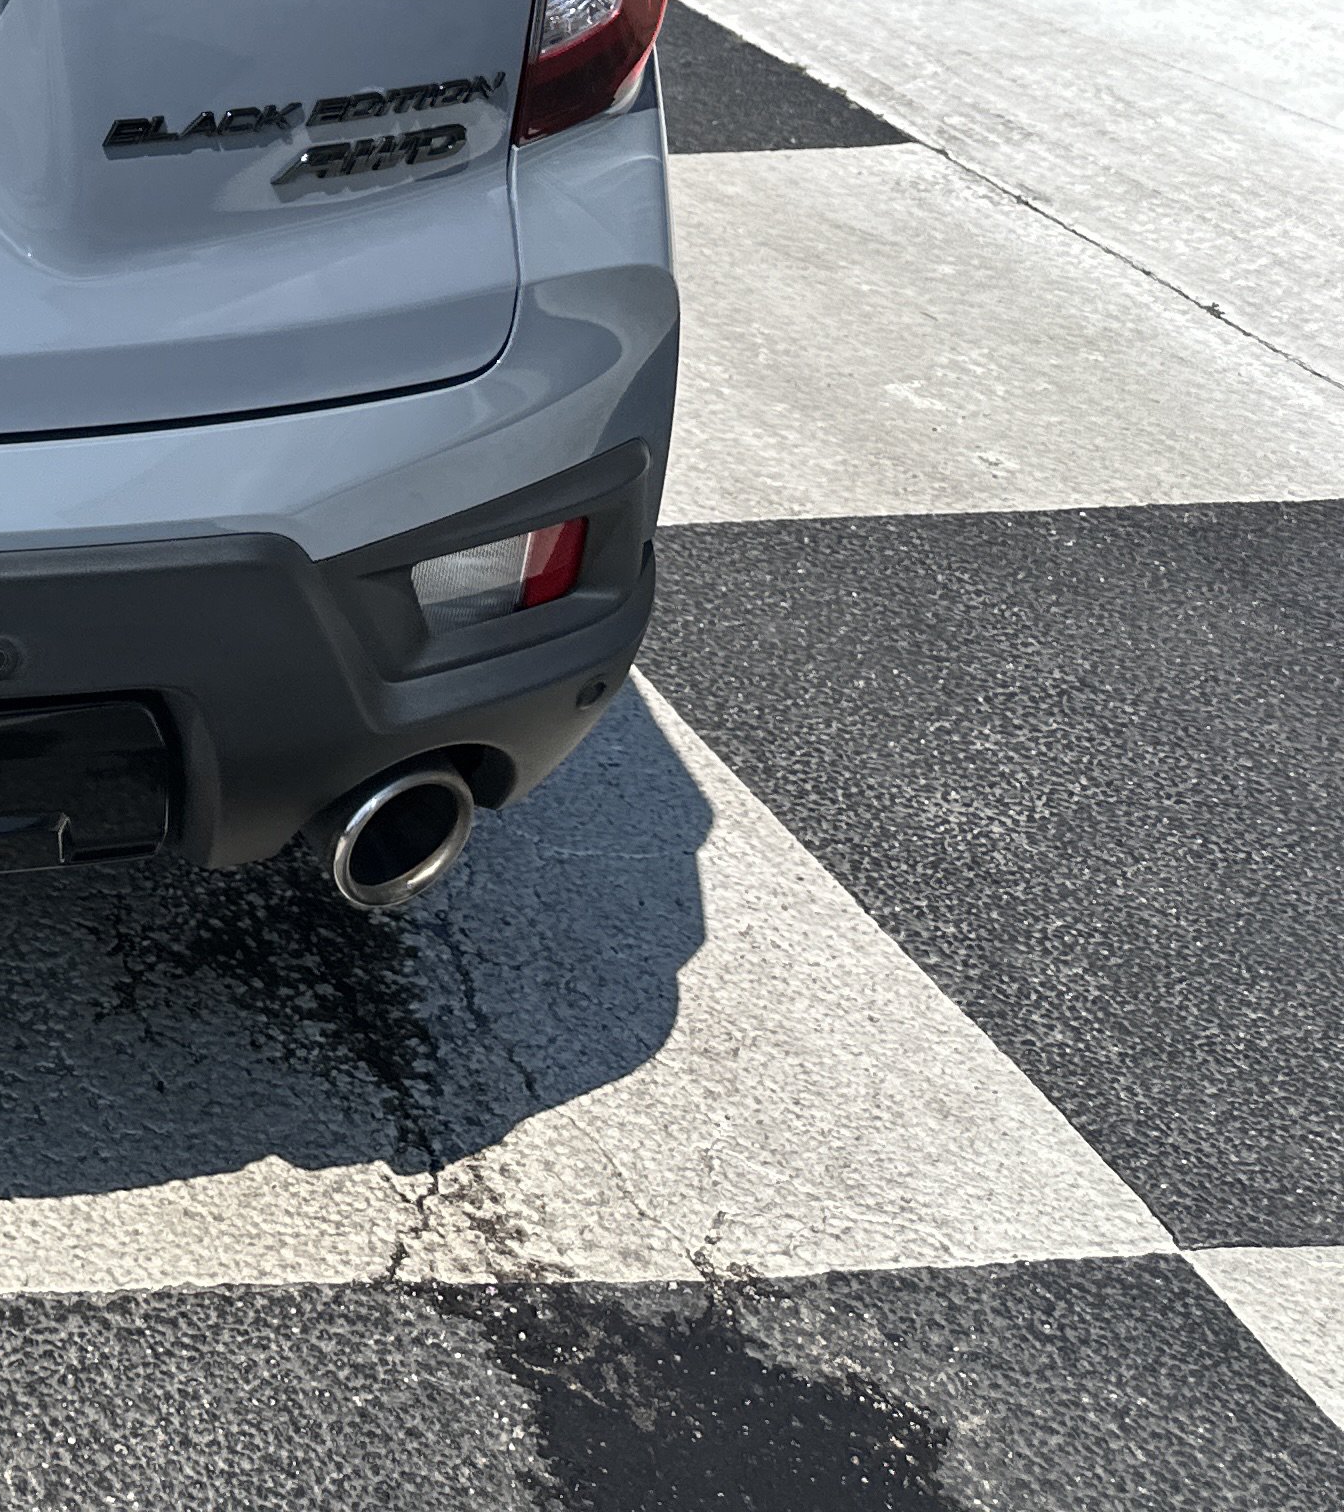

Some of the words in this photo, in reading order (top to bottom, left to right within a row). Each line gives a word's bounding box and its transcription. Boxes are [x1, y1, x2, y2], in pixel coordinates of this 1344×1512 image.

[101, 100, 302, 148] BLACK
[305, 71, 507, 127] EDITION
[269, 122, 468, 186] AWD
